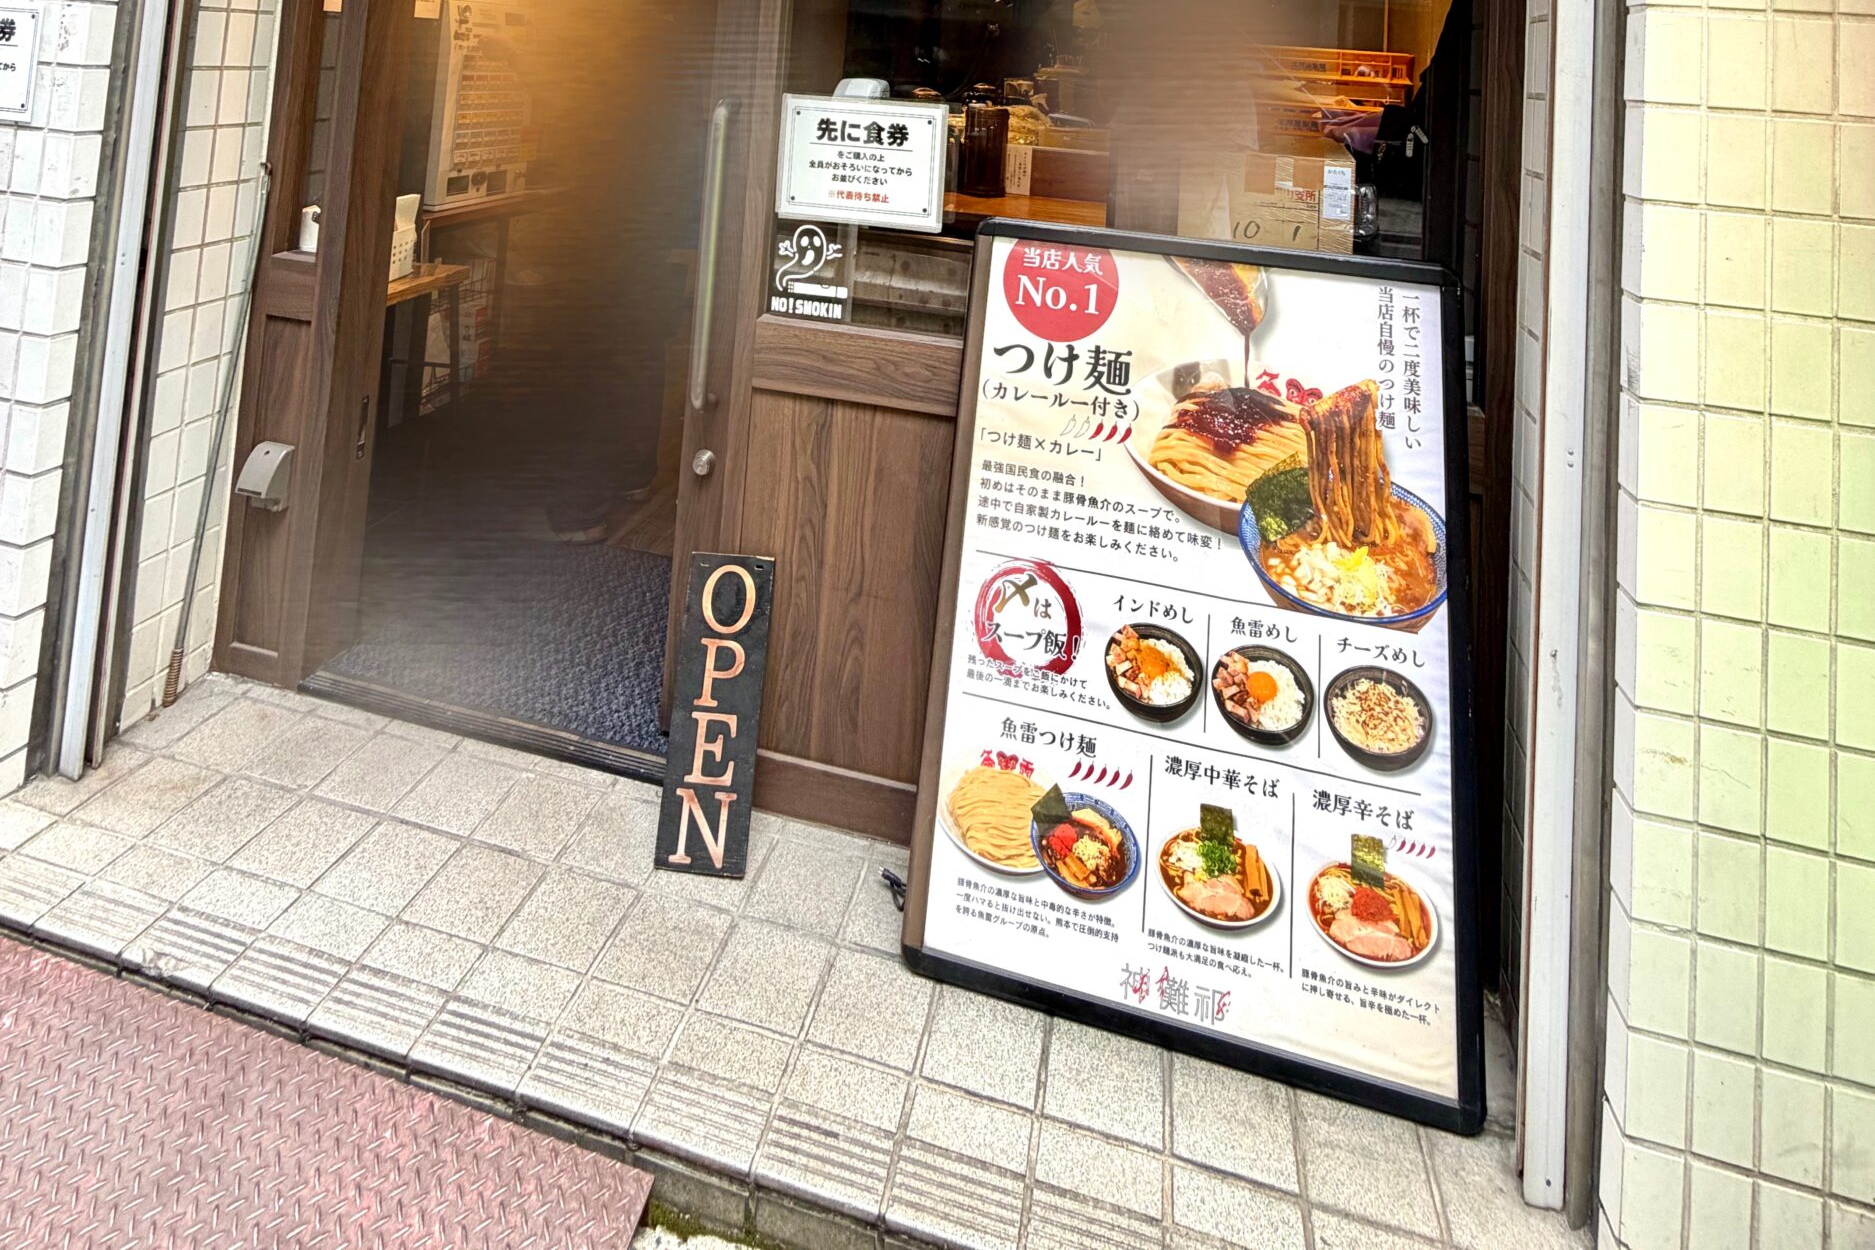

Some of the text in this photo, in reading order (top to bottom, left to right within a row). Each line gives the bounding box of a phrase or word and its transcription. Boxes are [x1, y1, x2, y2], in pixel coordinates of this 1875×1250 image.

[0, 62, 17, 72] から
[816, 117, 910, 147] 先に食券
[808, 160, 913, 177] 全員がおそろいになってから
[837, 150, 886, 162] をご購入の上
[831, 174, 888, 186] お並びください
[1023, 247, 1103, 276] 当店人気
[1015, 274, 1100, 315] No.1
[993, 342, 1133, 396] つけ麺
[1376, 286, 1396, 430] 当店自慢のつけ麺
[1402, 294, 1422, 450] 一杯で二度美味しい
[982, 379, 1140, 421] （カレールー付き）
[981, 459, 1086, 488] 最強国民食の融合！
[979, 477, 1183, 524] 初めはそのまま豚骨魚介のスープで。
[976, 513, 1180, 563] 新感覚のつけ麺をお楽しみください。
[978, 495, 1222, 550] 途中で自家製カレールーを麺に絡めて味変！
[1113, 594, 1194, 624] インドめし
[1230, 616, 1298, 643] 魚雷めし
[1336, 637, 1426, 668] チーズめし
[668, 564, 756, 869] OPEN
[1000, 717, 1097, 759] 魚雷つけ麺
[1165, 754, 1280, 799] 濃厚中華そば
[1312, 789, 1415, 831] 濃厚辛そば
